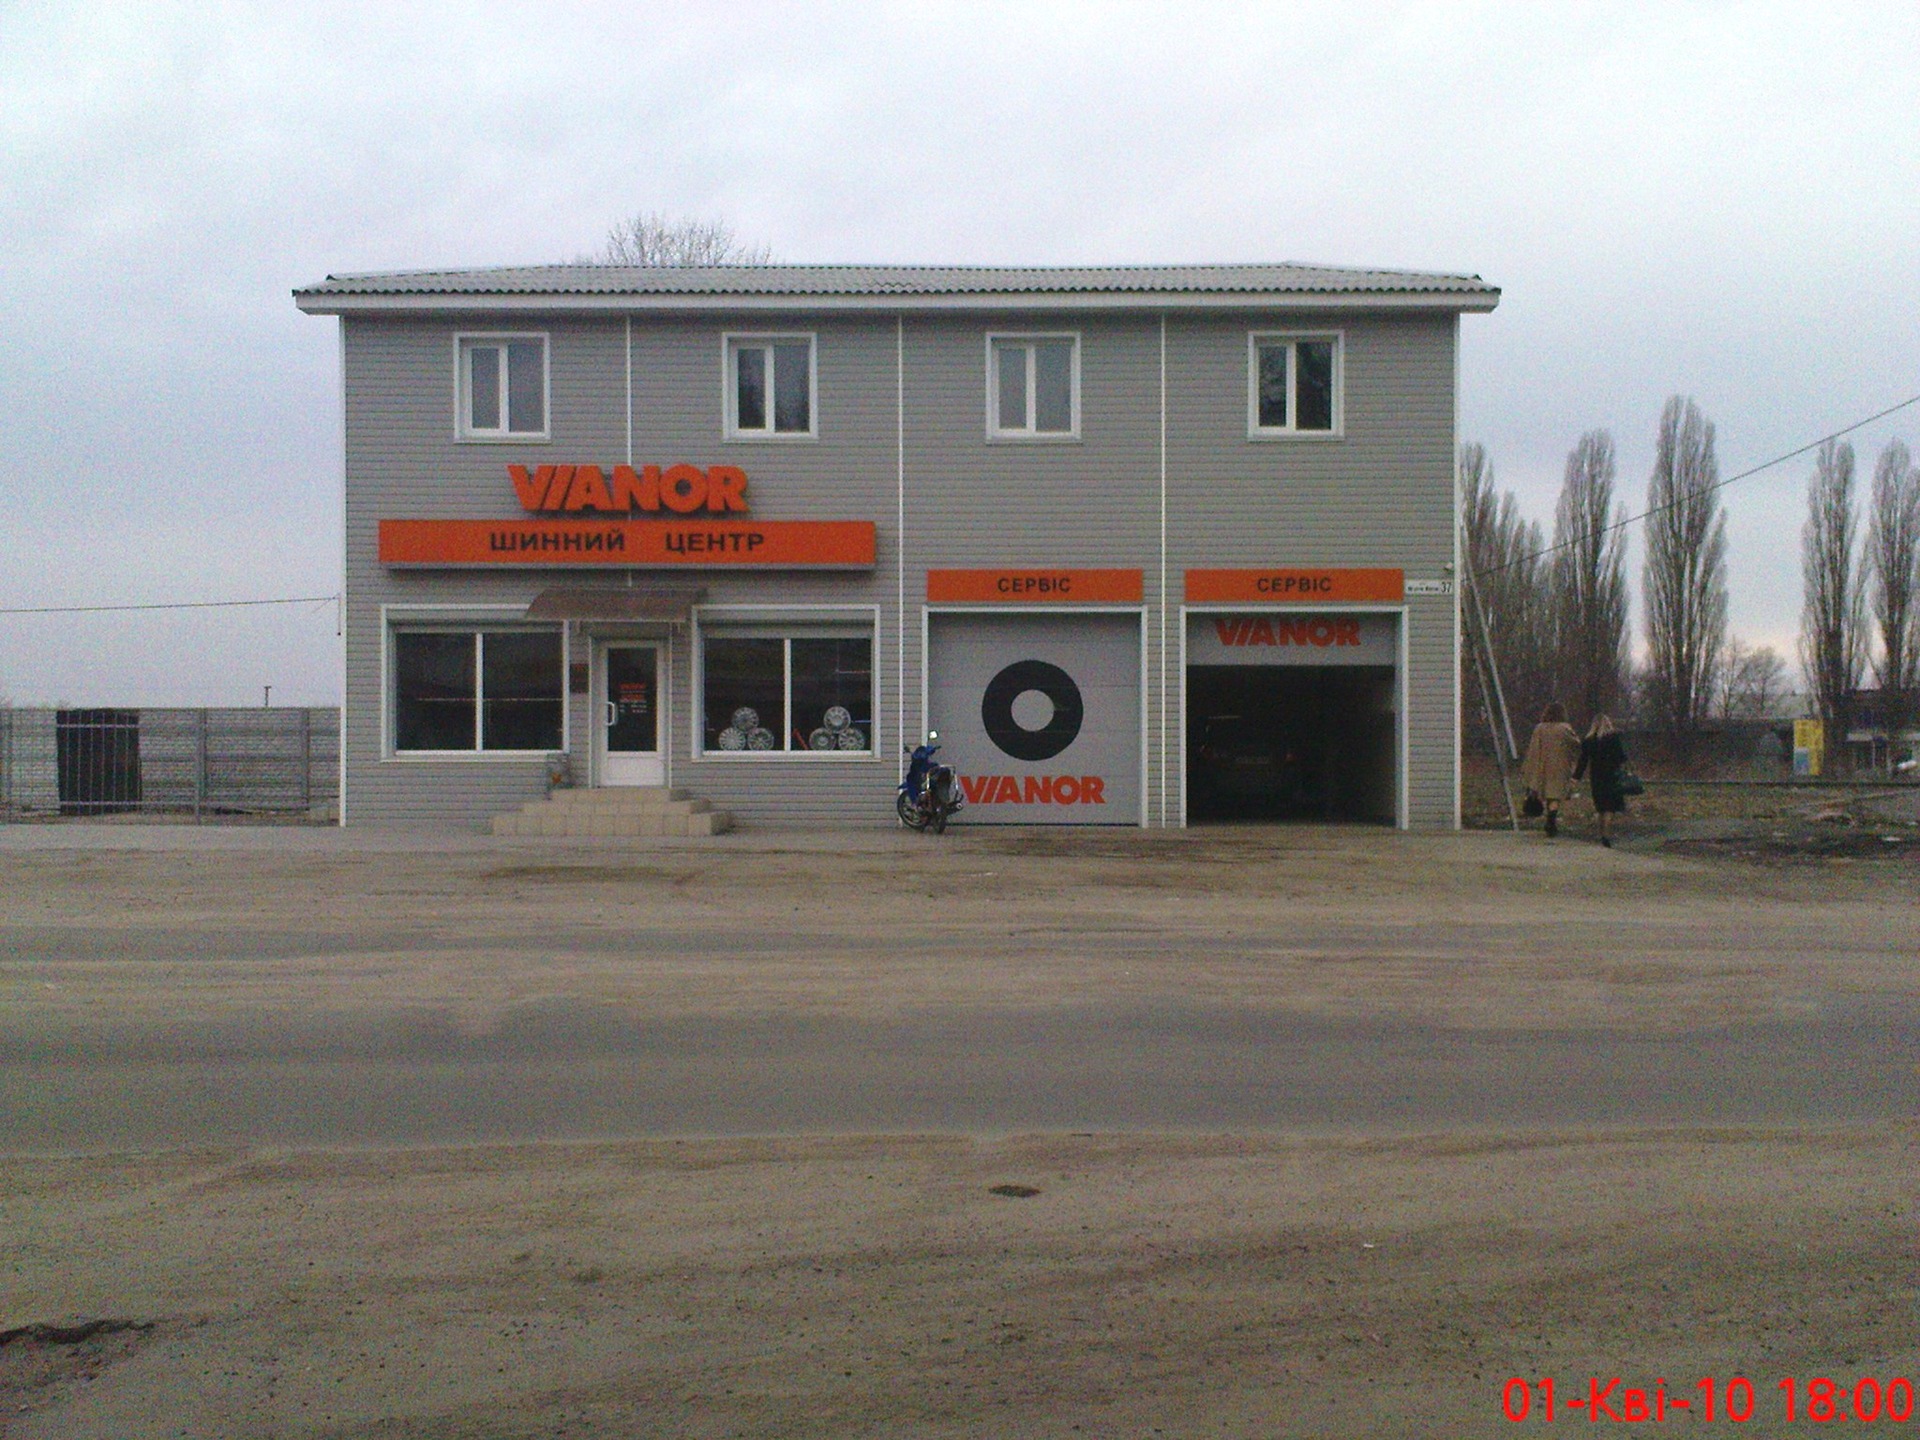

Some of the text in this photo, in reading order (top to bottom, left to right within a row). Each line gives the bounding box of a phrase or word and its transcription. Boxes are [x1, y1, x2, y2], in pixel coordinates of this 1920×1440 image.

[507, 464, 748, 512] VIANOR
[490, 529, 764, 554] ШИННИЙ ЦЕНТР
[997, 577, 1071, 593] СЕРВІС
[1257, 577, 1332, 593] СЕРВІС
[1441, 581, 1452, 593] 37
[1215, 617, 1361, 647] VIANOR
[960, 775, 1106, 805] VIANOR
